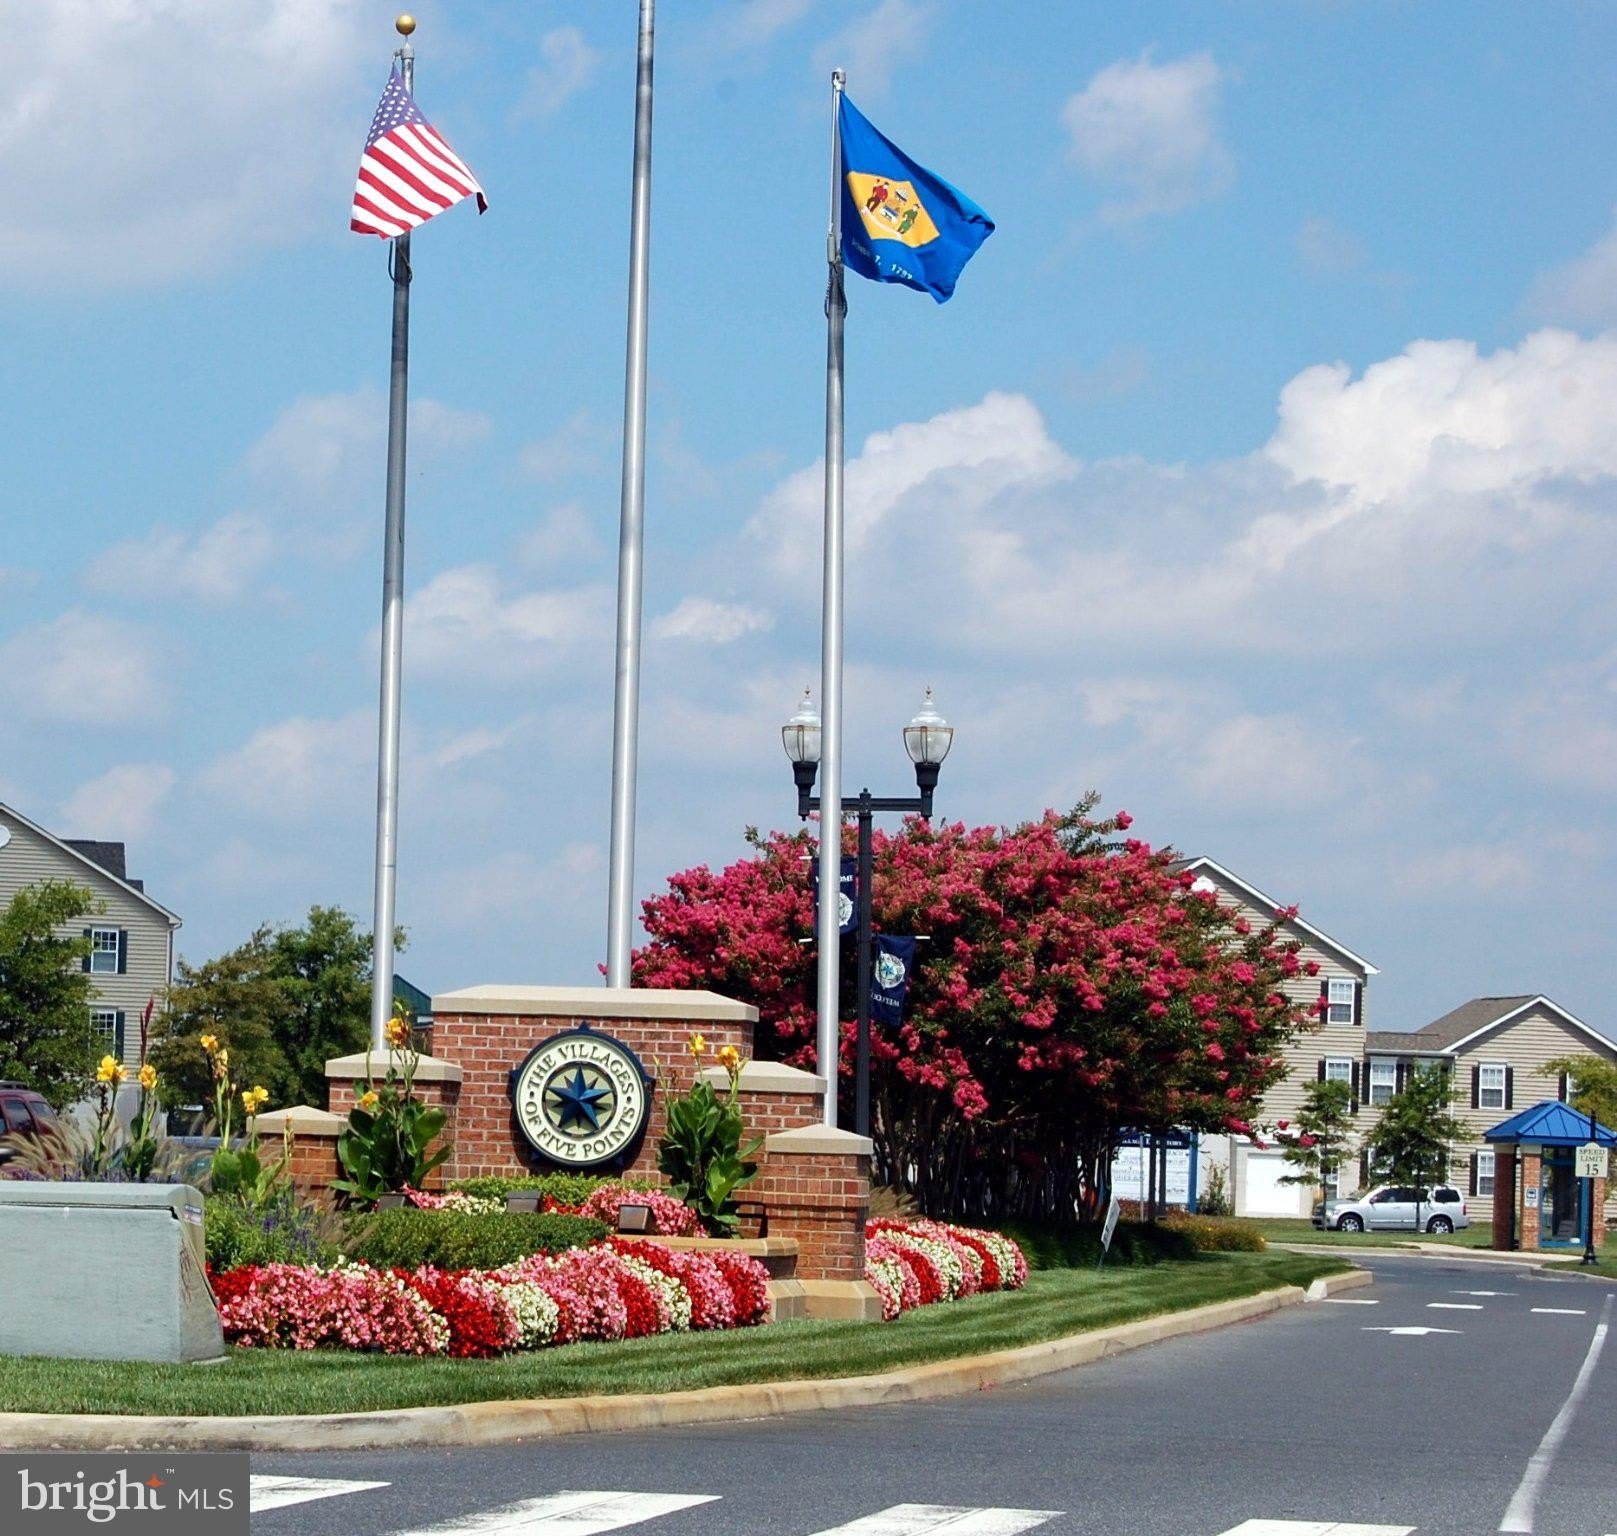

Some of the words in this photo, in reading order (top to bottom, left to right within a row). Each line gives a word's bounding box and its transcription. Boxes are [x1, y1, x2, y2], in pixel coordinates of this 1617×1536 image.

[527, 1054, 557, 1090] THE
[558, 1043, 635, 1095] VILLAGES
[525, 1101, 541, 1126] OF
[537, 1127, 577, 1157] FIVE
[582, 1106, 636, 1158] POINTS
[1586, 1163, 1599, 1176] 15
